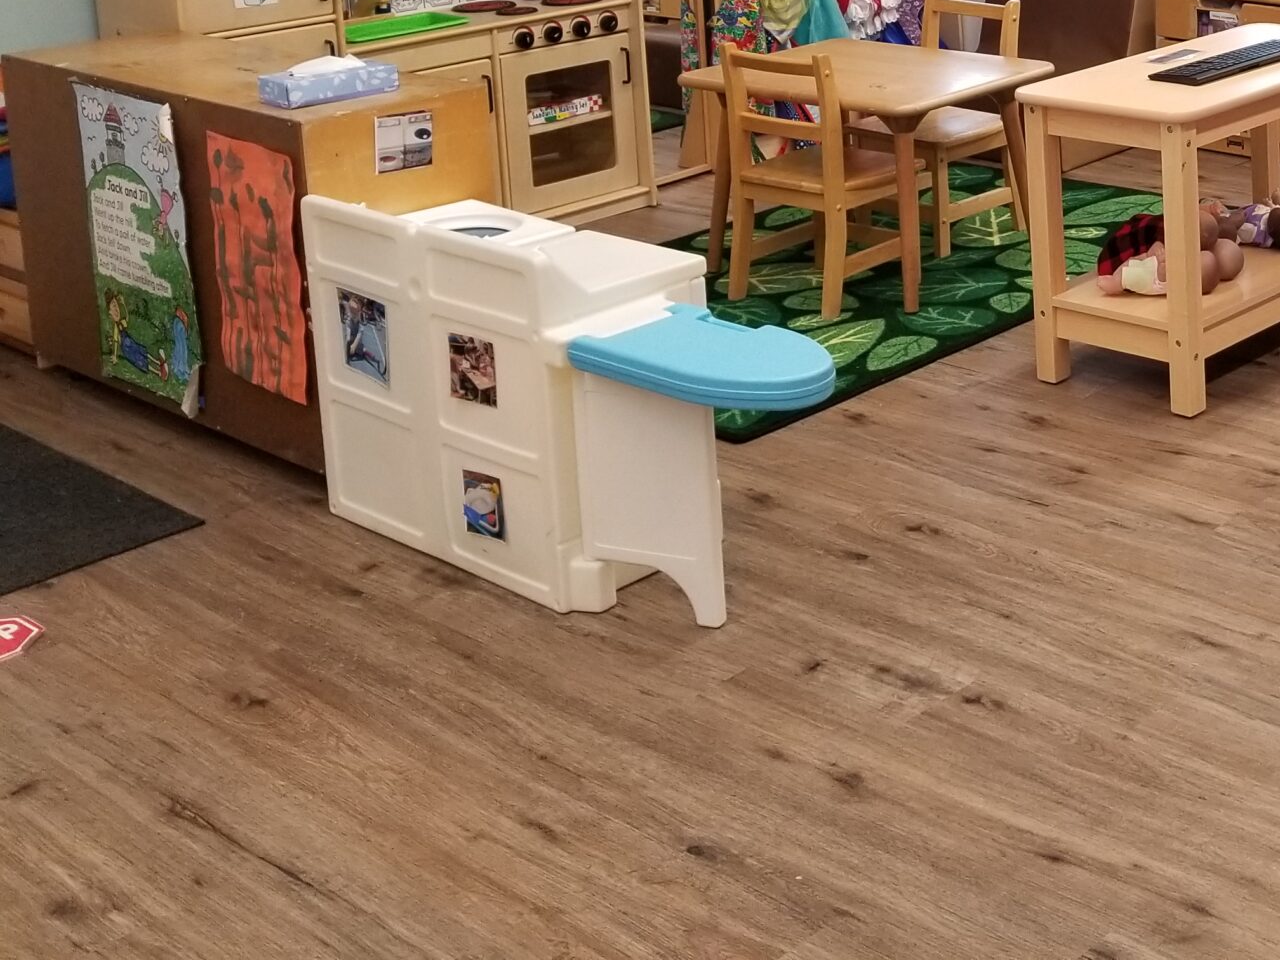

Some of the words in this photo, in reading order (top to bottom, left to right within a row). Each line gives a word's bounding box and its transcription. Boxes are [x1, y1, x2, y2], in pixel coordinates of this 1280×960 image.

[559, 103, 578, 112] Making
[579, 100, 588, 109] Set
[106, 179, 123, 195] Jack
[125, 187, 138, 200] and
[139, 189, 149, 203] Jill
[117, 241, 131, 252] down
[137, 237, 151, 248] water
